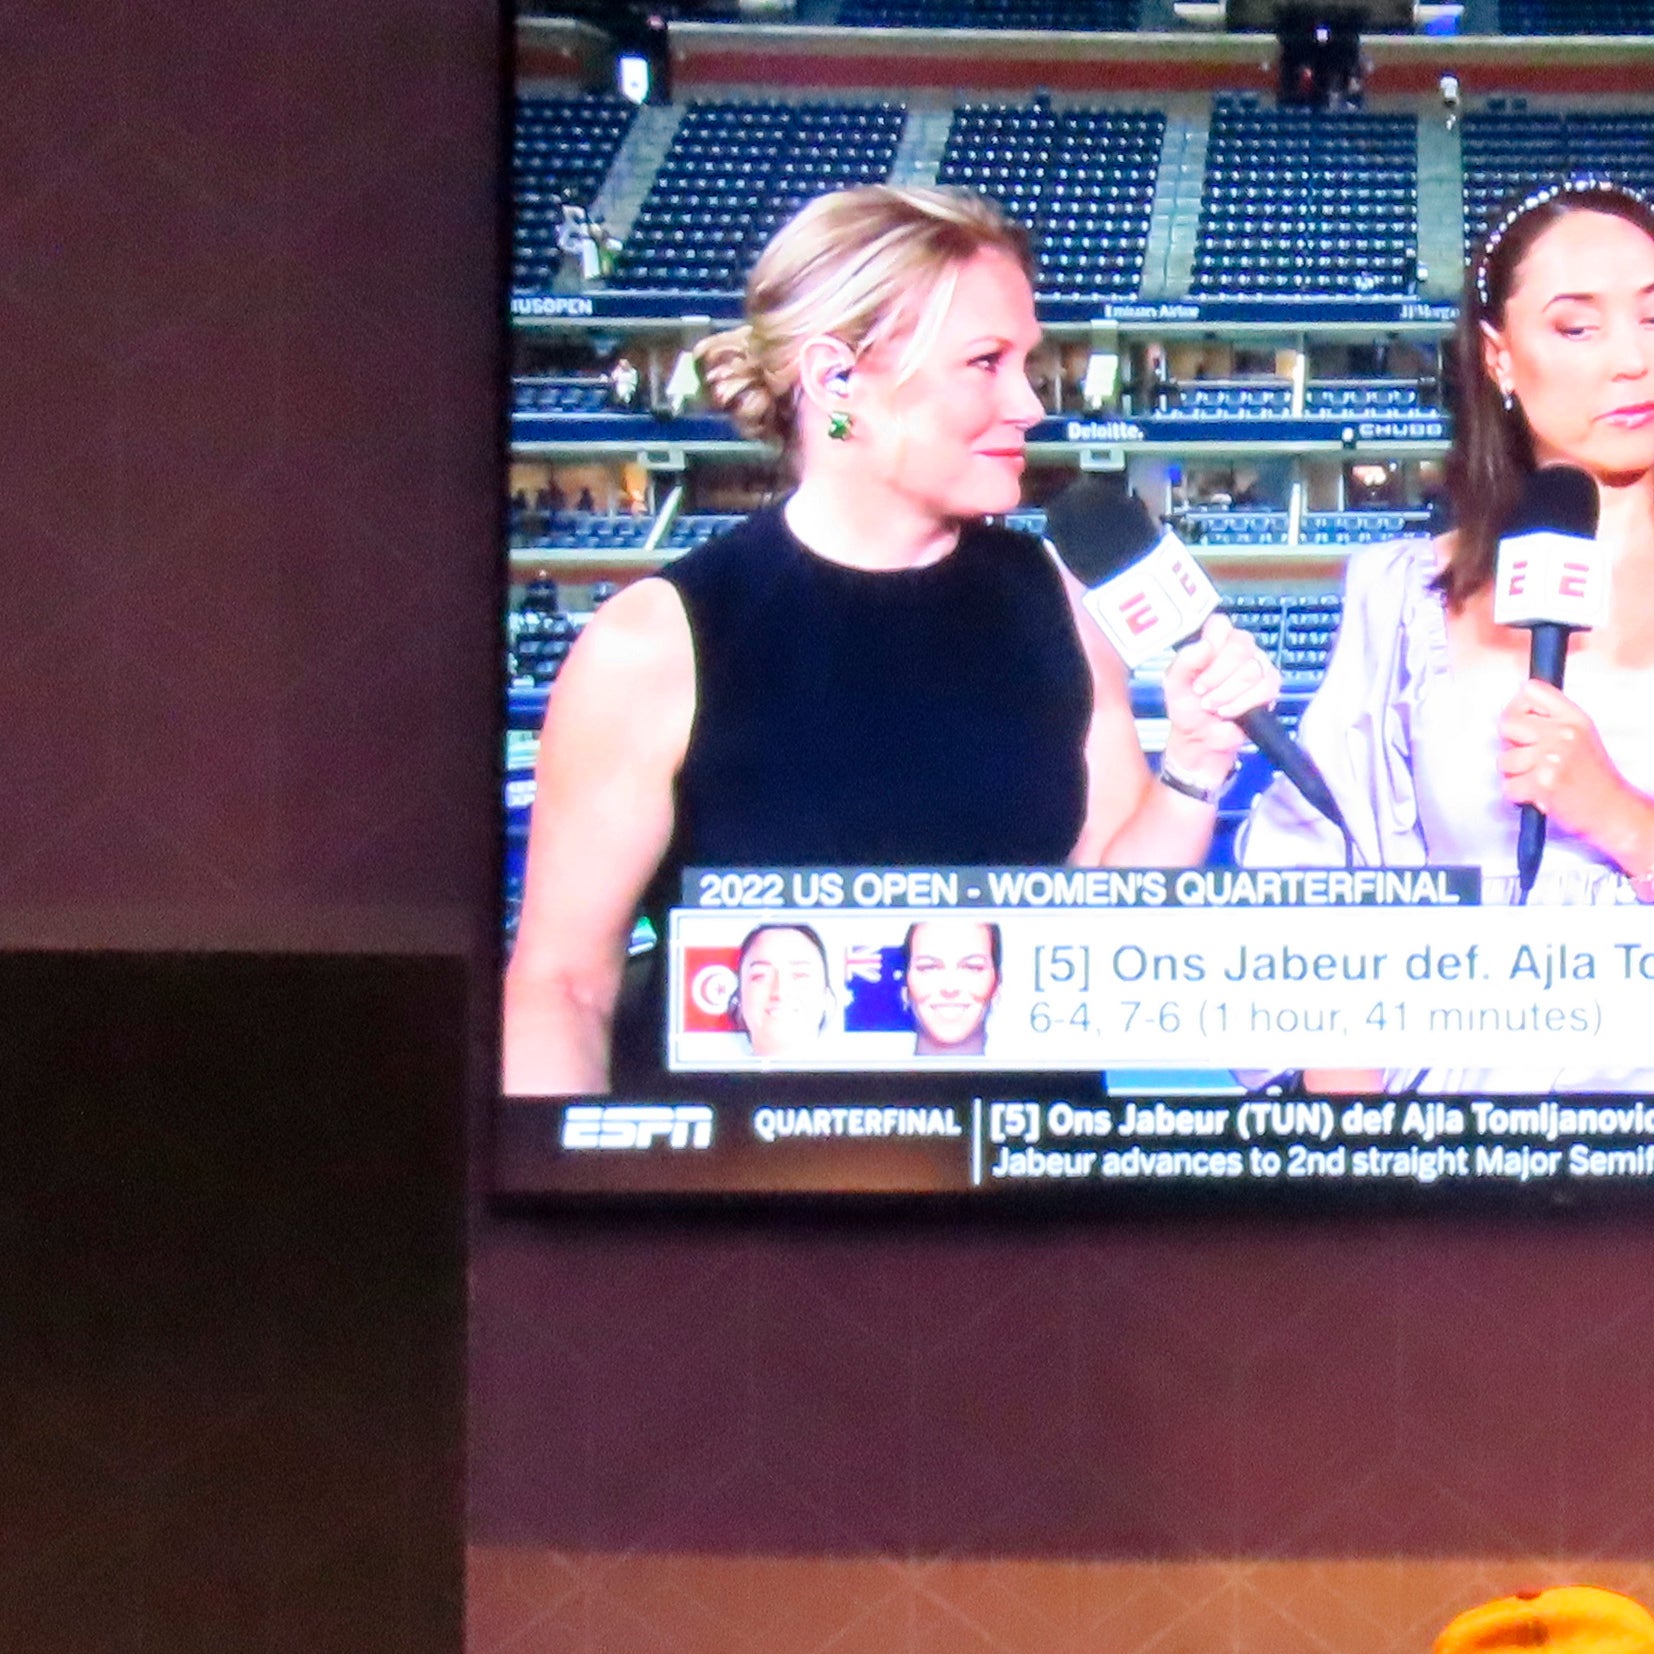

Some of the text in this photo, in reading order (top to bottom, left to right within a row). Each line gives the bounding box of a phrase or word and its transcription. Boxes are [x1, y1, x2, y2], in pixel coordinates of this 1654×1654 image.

[699, 872, 785, 907] 2022
[793, 872, 844, 906] US
[852, 871, 958, 906] OPEN
[987, 871, 1168, 906] WOMEN'S
[1175, 870, 1461, 907] QUARTERFINAL
[1034, 943, 1091, 993] [5]
[1112, 944, 1207, 982] Ons
[1223, 944, 1388, 982] Jabeur
[1405, 943, 1490, 982] def.
[1508, 942, 1596, 991] Ajla
[1029, 999, 1603, 1037] 6-4, 7-6 (1 hour, 41 minutes)
[561, 1104, 963, 1150] ESPN QUARTERFINAL
[989, 1102, 1041, 1144] [5]
[1046, 1102, 1113, 1137] Ons
[1117, 1102, 1231, 1137] Jabeur
[1236, 1101, 1335, 1141] (TUN)
[1341, 1101, 1397, 1136] def
[1401, 1101, 1464, 1141] Ajla
[991, 1146, 1097, 1178] Jabeur
[1102, 1147, 1244, 1178] advances
[1249, 1148, 1281, 1177] to
[1286, 1145, 1346, 1177] 2nd
[1352, 1145, 1469, 1183] straight
[1475, 1146, 1562, 1181] Major
